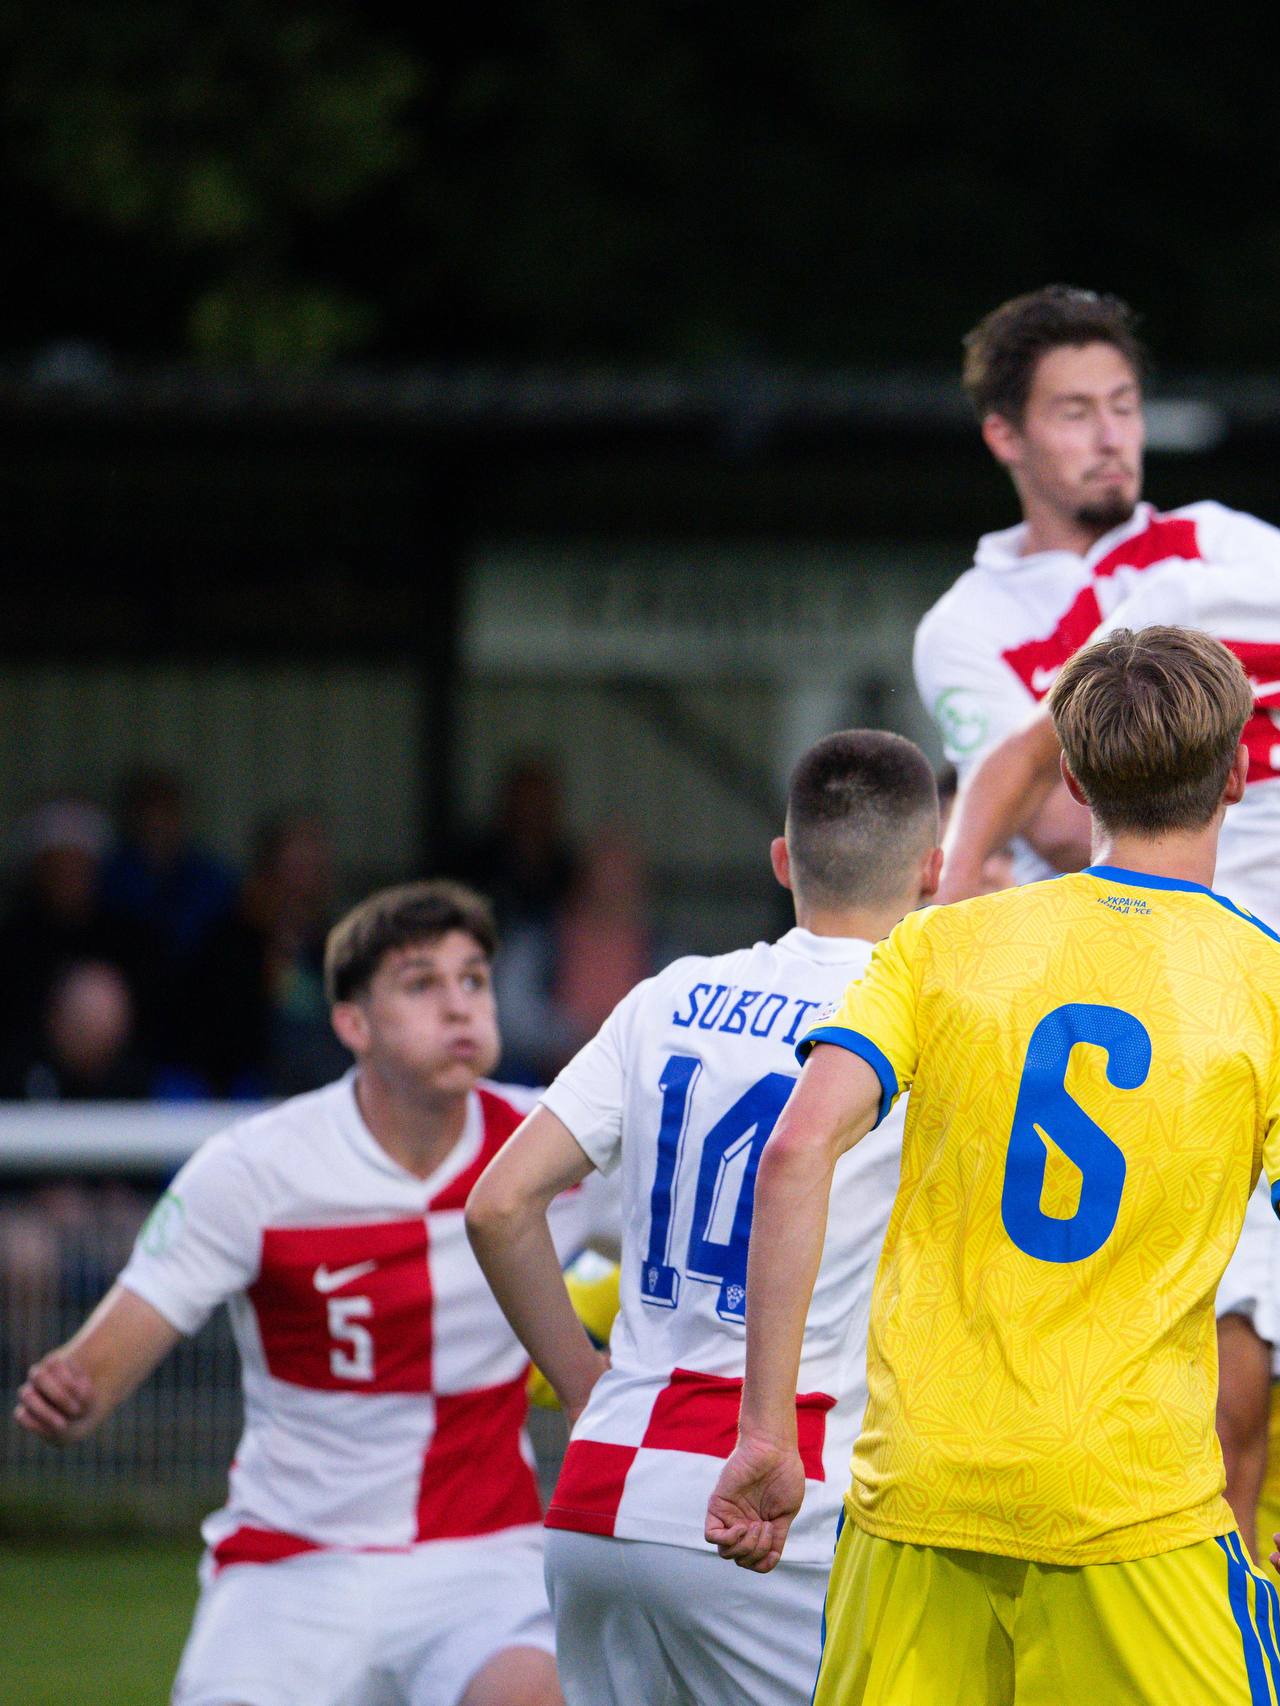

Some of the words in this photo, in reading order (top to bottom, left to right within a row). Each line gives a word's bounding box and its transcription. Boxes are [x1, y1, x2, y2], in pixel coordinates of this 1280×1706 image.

[672, 982, 821, 1046] SUBOT
[640, 1054, 799, 1326] 14
[1001, 1002, 1153, 1264] 6
[326, 1295, 375, 1381] 5
